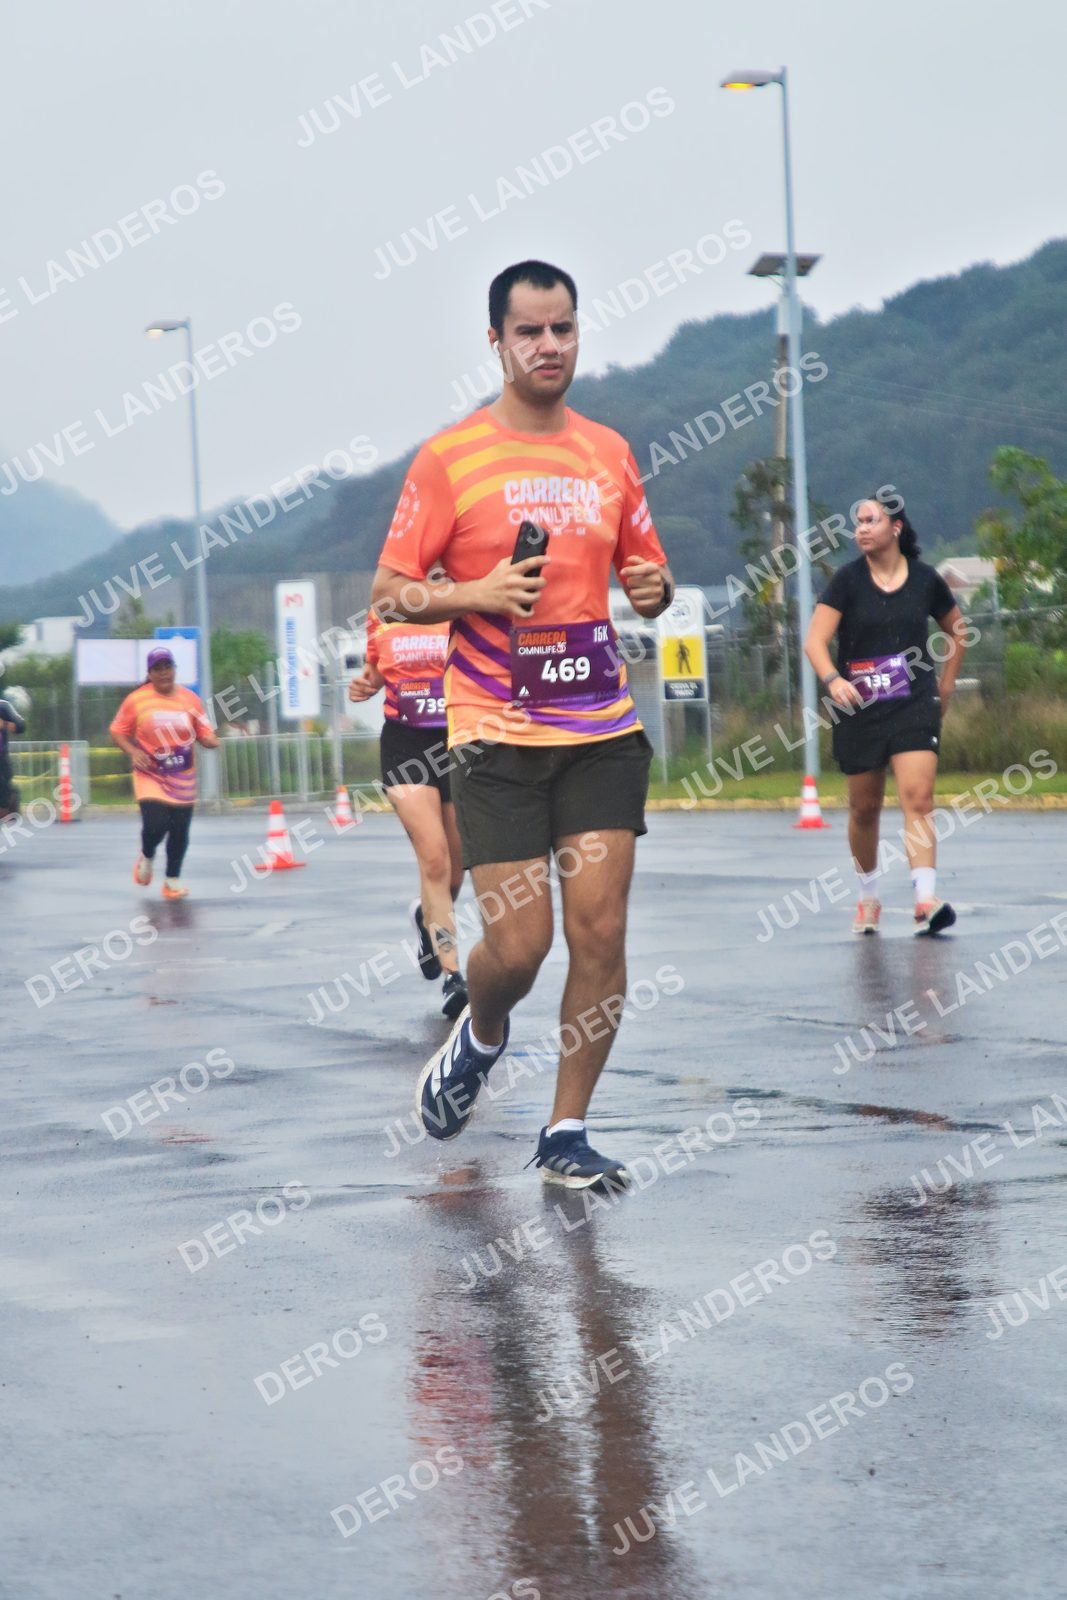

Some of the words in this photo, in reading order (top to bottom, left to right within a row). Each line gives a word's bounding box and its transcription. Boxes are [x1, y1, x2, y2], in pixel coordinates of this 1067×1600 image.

[504, 477, 600, 505] CARRERA
[518, 631, 567, 647] CARRERA
[541, 656, 590, 683] 469
[864, 673, 891, 688] 135
[416, 698, 446, 713] 739
